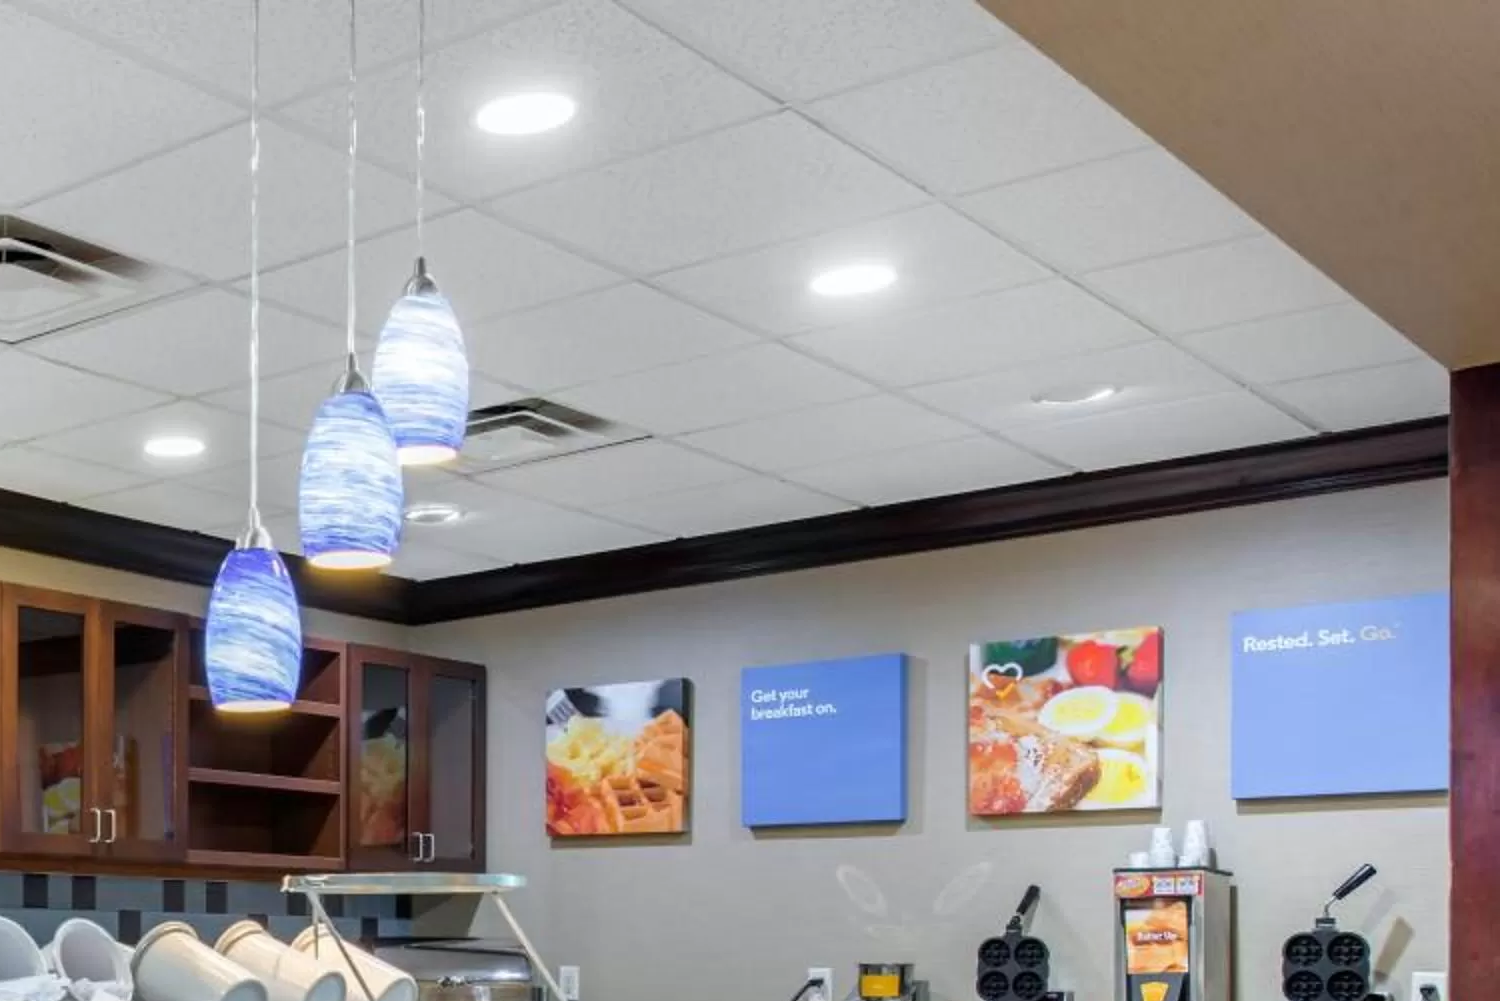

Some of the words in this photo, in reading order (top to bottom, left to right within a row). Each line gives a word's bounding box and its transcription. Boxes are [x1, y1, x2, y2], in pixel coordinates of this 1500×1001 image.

[1243, 631, 1313, 652] Rested.
[1317, 629, 1356, 646] Set.
[751, 689, 777, 703] Get
[779, 688, 809, 707] your
[751, 703, 813, 720] breakfast
[815, 703, 837, 715] on.
